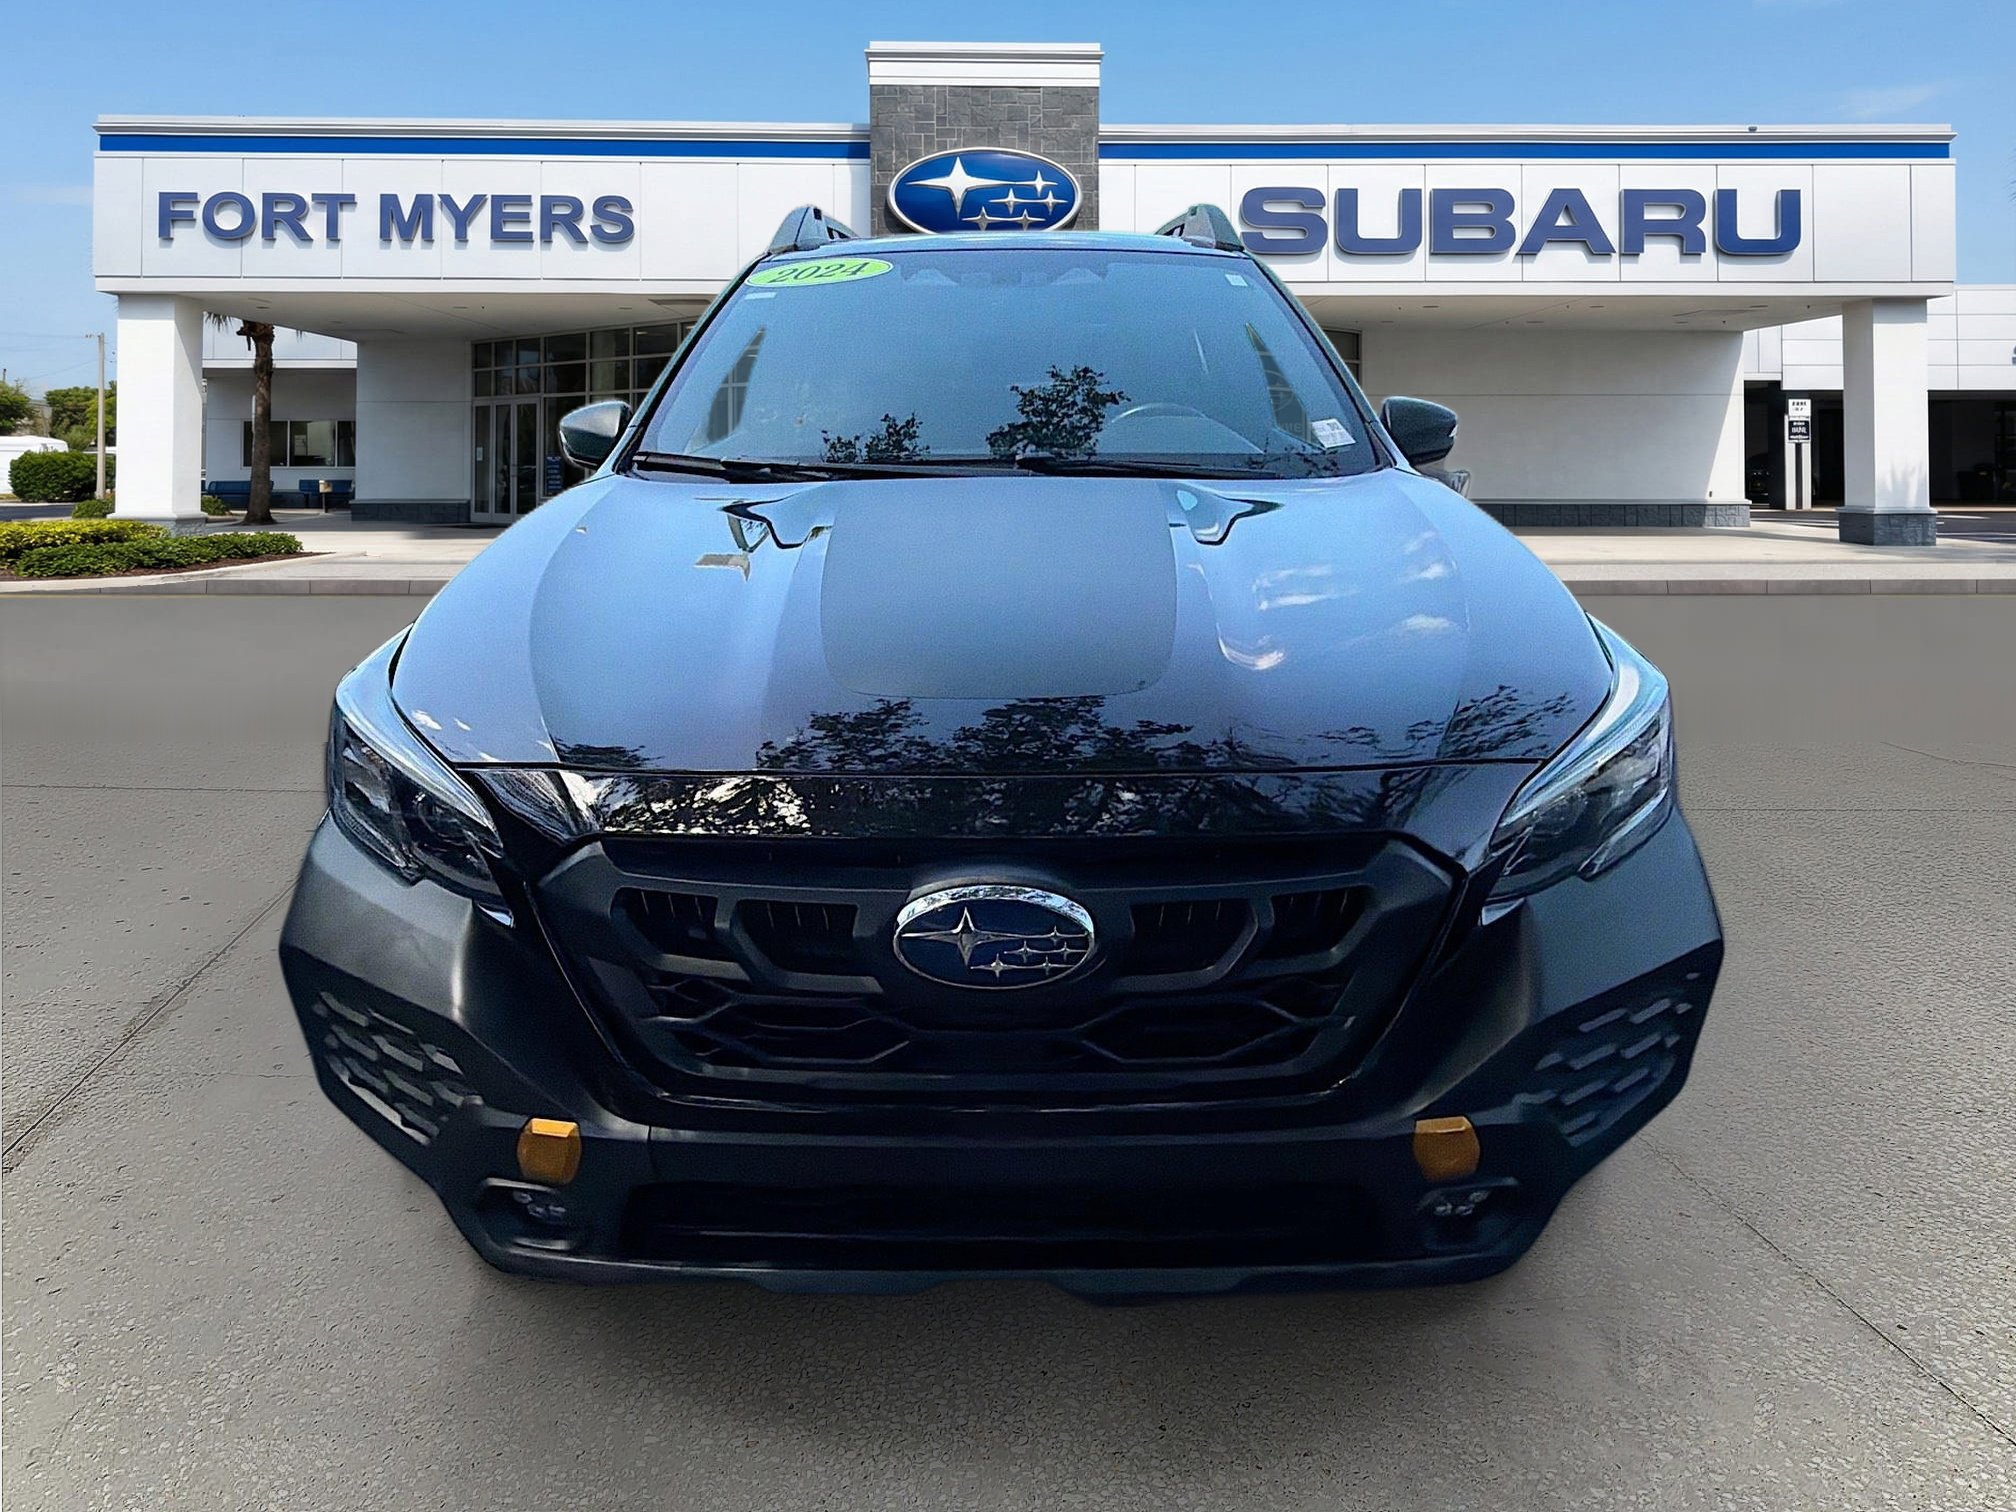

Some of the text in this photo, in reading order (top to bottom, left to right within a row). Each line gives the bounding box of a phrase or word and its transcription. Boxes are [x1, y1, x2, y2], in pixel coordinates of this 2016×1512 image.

[158, 191, 635, 246] FORT MYERS
[1241, 187, 1801, 257] SUBARU
[768, 261, 871, 284] 2024
